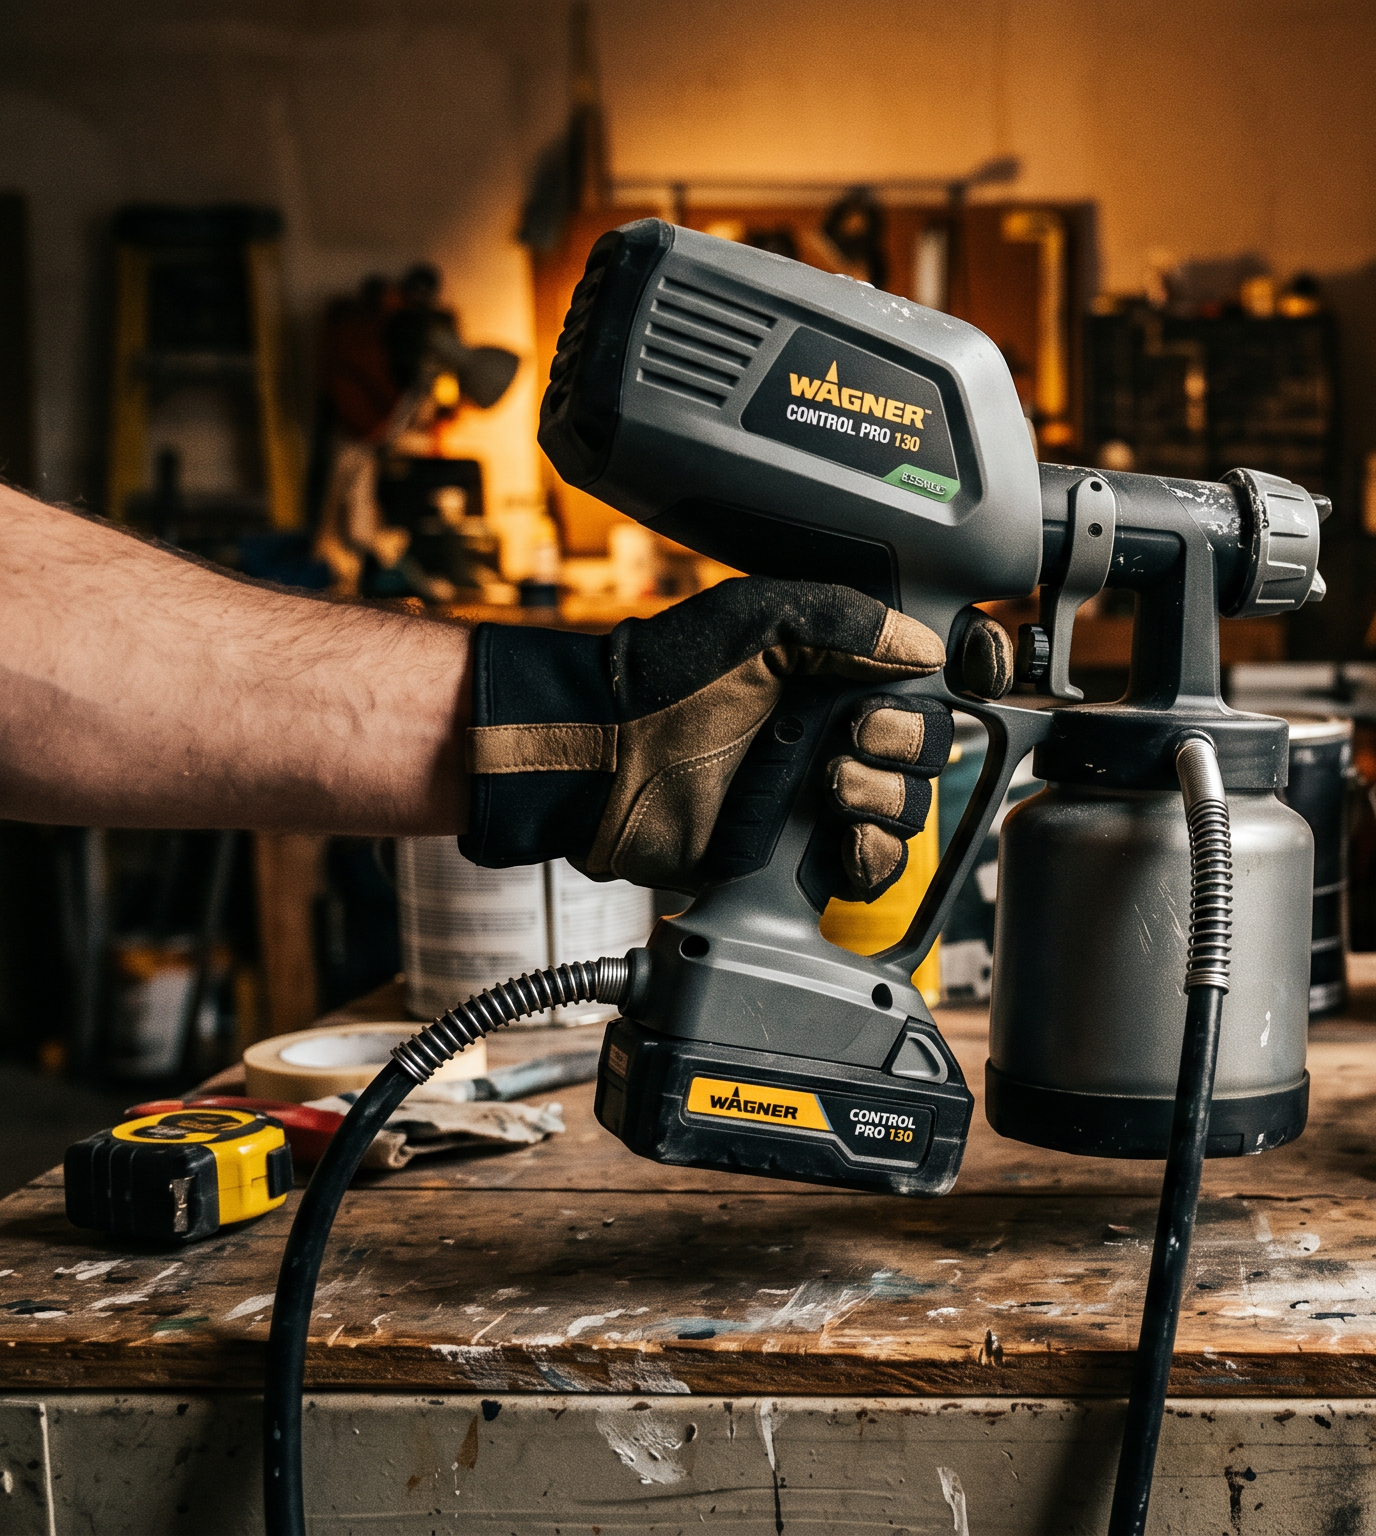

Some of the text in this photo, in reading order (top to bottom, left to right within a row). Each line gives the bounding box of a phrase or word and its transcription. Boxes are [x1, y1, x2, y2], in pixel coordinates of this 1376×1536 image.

[789, 360, 925, 430] WAGNER
[786, 404, 921, 453] CONTROL PRO 130
[709, 1086, 799, 1120] WAGNER
[849, 1108, 916, 1129] CONTROL
[854, 1125, 914, 1143] PRO 130
